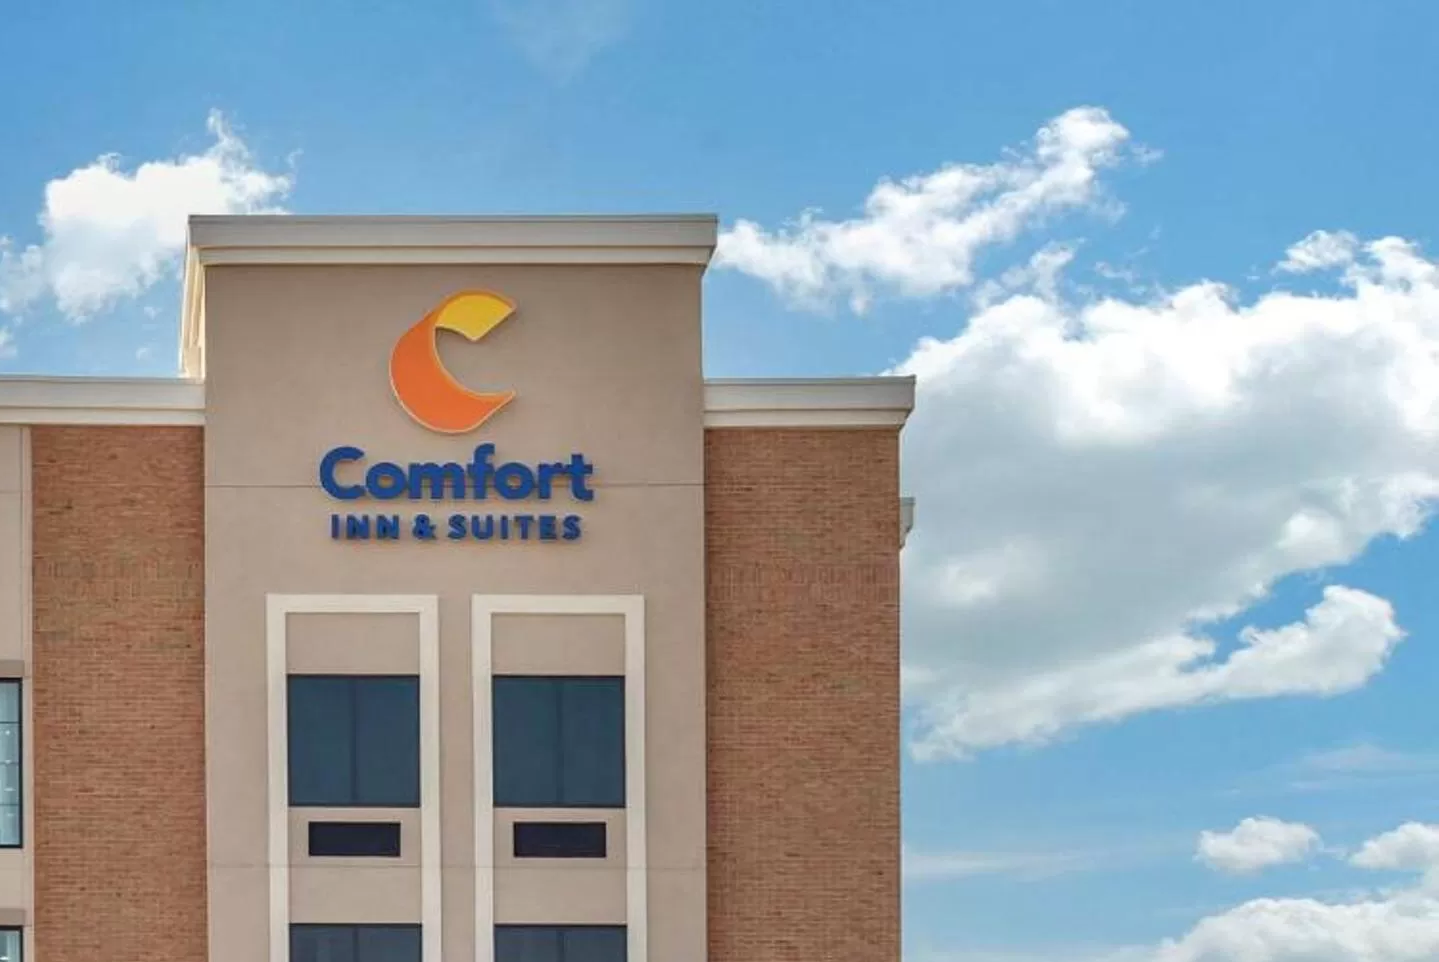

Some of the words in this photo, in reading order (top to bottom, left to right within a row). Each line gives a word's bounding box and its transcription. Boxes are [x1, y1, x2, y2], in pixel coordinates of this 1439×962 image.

[319, 443, 594, 501] Comfort
[330, 514, 400, 540] INN
[412, 514, 437, 540] &
[447, 514, 583, 540] SUITES
